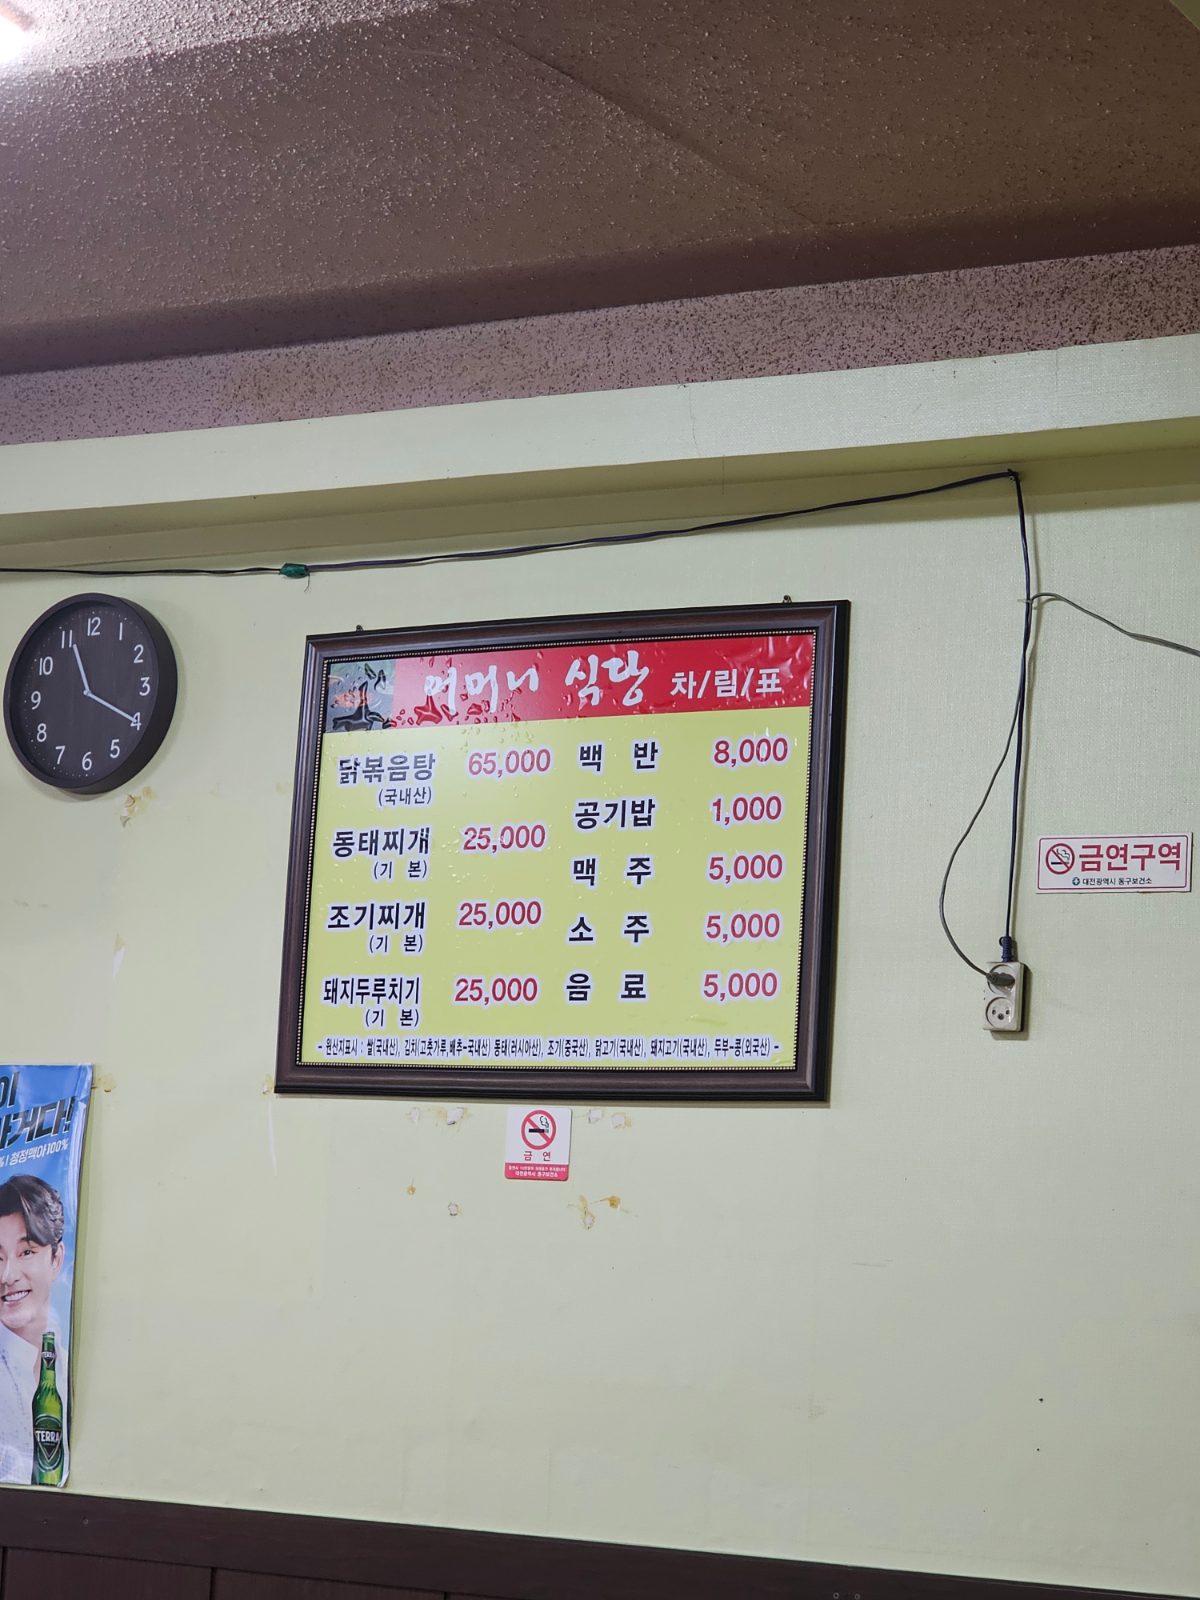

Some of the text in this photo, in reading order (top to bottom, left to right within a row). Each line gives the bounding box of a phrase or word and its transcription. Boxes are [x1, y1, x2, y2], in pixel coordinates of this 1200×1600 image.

[87, 617, 101, 636] 12
[61, 629, 73, 649] 11
[133, 644, 144, 664] 2
[39, 656, 54, 676] 10
[139, 676, 151, 696] 3
[565, 650, 649, 706] 식당
[670, 667, 783, 700] 차/림/표
[31, 690, 42, 710] 9
[130, 712, 142, 731] 4
[36, 723, 47, 743] 8
[55, 745, 66, 765] 7
[110, 739, 120, 759] 5
[713, 737, 788, 768] 8,000
[81, 751, 92, 771] 6
[338, 748, 551, 785] 닭볶음탕 65,000
[378, 786, 432, 807] (국내산)
[575, 795, 782, 829] 공기밥 1,000
[333, 824, 546, 858] 동태찌개 25,000
[1079, 842, 1181, 872] 금연구역
[709, 854, 783, 884] 5,000
[1082, 877, 1116, 886] 대전광역시
[327, 901, 542, 930] 조기찌개 25,000
[706, 913, 780, 943] 5,000
[323, 977, 538, 1006] 돼지두루치기 25,000
[703, 972, 778, 1001] 5,000
[35, 1430, 60, 1443] TERRA
